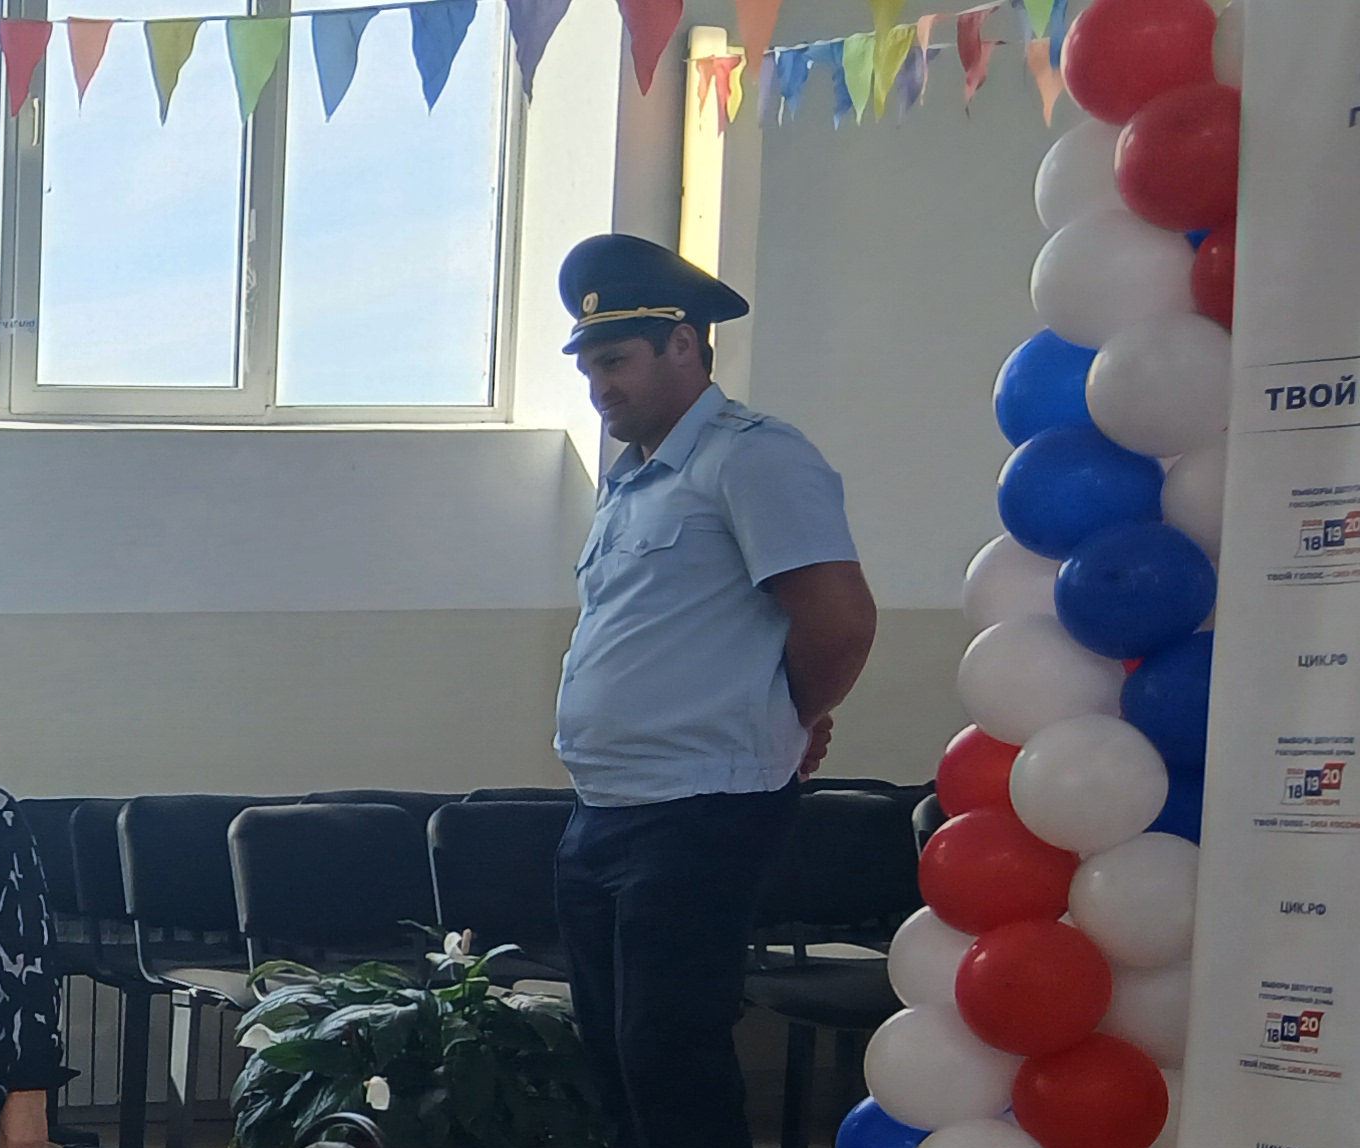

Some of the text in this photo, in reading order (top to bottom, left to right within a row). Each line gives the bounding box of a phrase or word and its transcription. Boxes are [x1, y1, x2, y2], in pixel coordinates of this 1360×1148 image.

[1264, 374, 1356, 411] ТВОЙ
[1303, 536, 1321, 551] 18
[1326, 526, 1342, 542] 19
[1288, 769, 1340, 799] 18 19 20
[1280, 901, 1327, 915] ЦИК.РФ
[1267, 1016, 1319, 1043] 18 19 20
